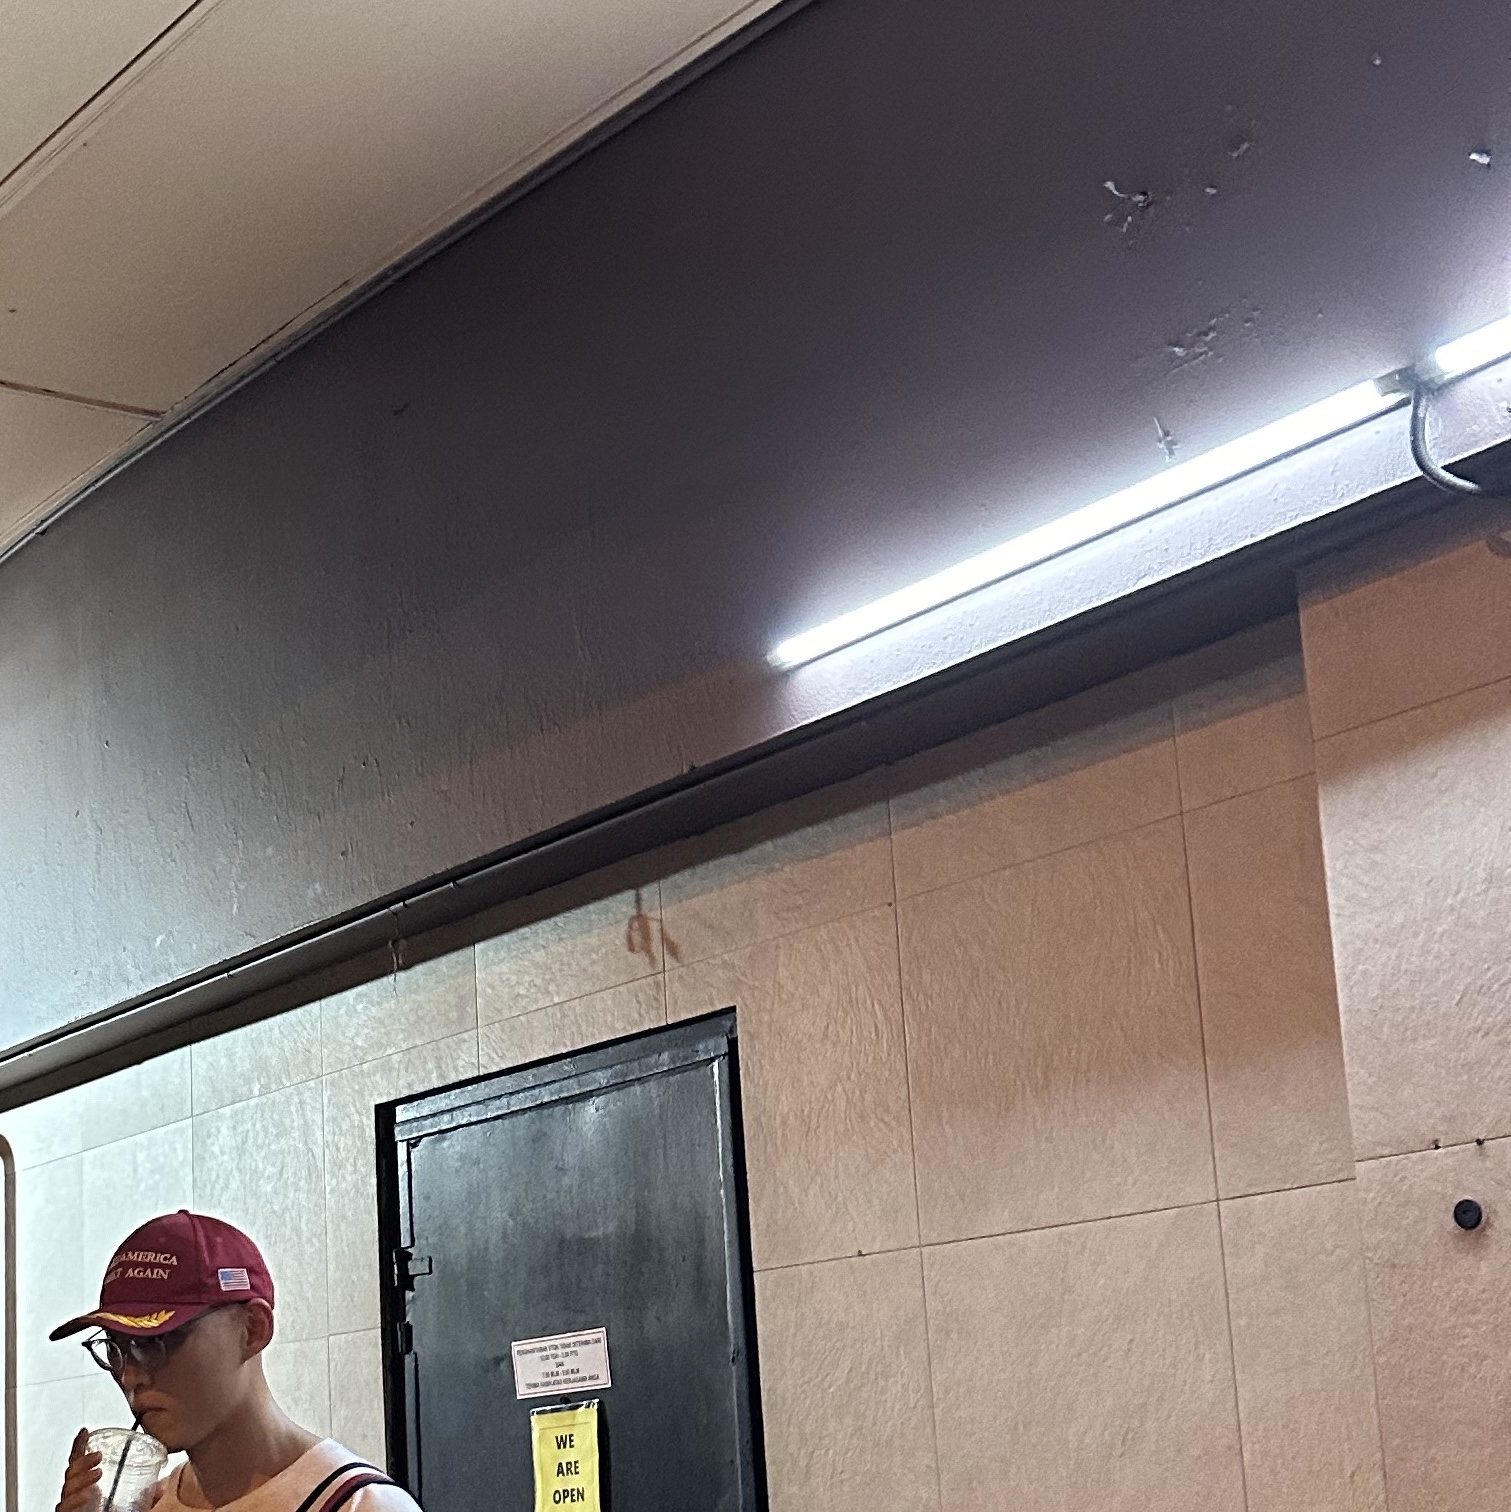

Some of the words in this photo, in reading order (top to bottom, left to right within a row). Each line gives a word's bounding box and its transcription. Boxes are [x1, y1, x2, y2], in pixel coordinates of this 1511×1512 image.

[120, 1250, 178, 1266] AMERICA
[125, 1266, 171, 1280] AGAIN
[555, 1433, 575, 1450] WE
[556, 1460, 580, 1477] ARE
[553, 1487, 585, 1505] OPEN
